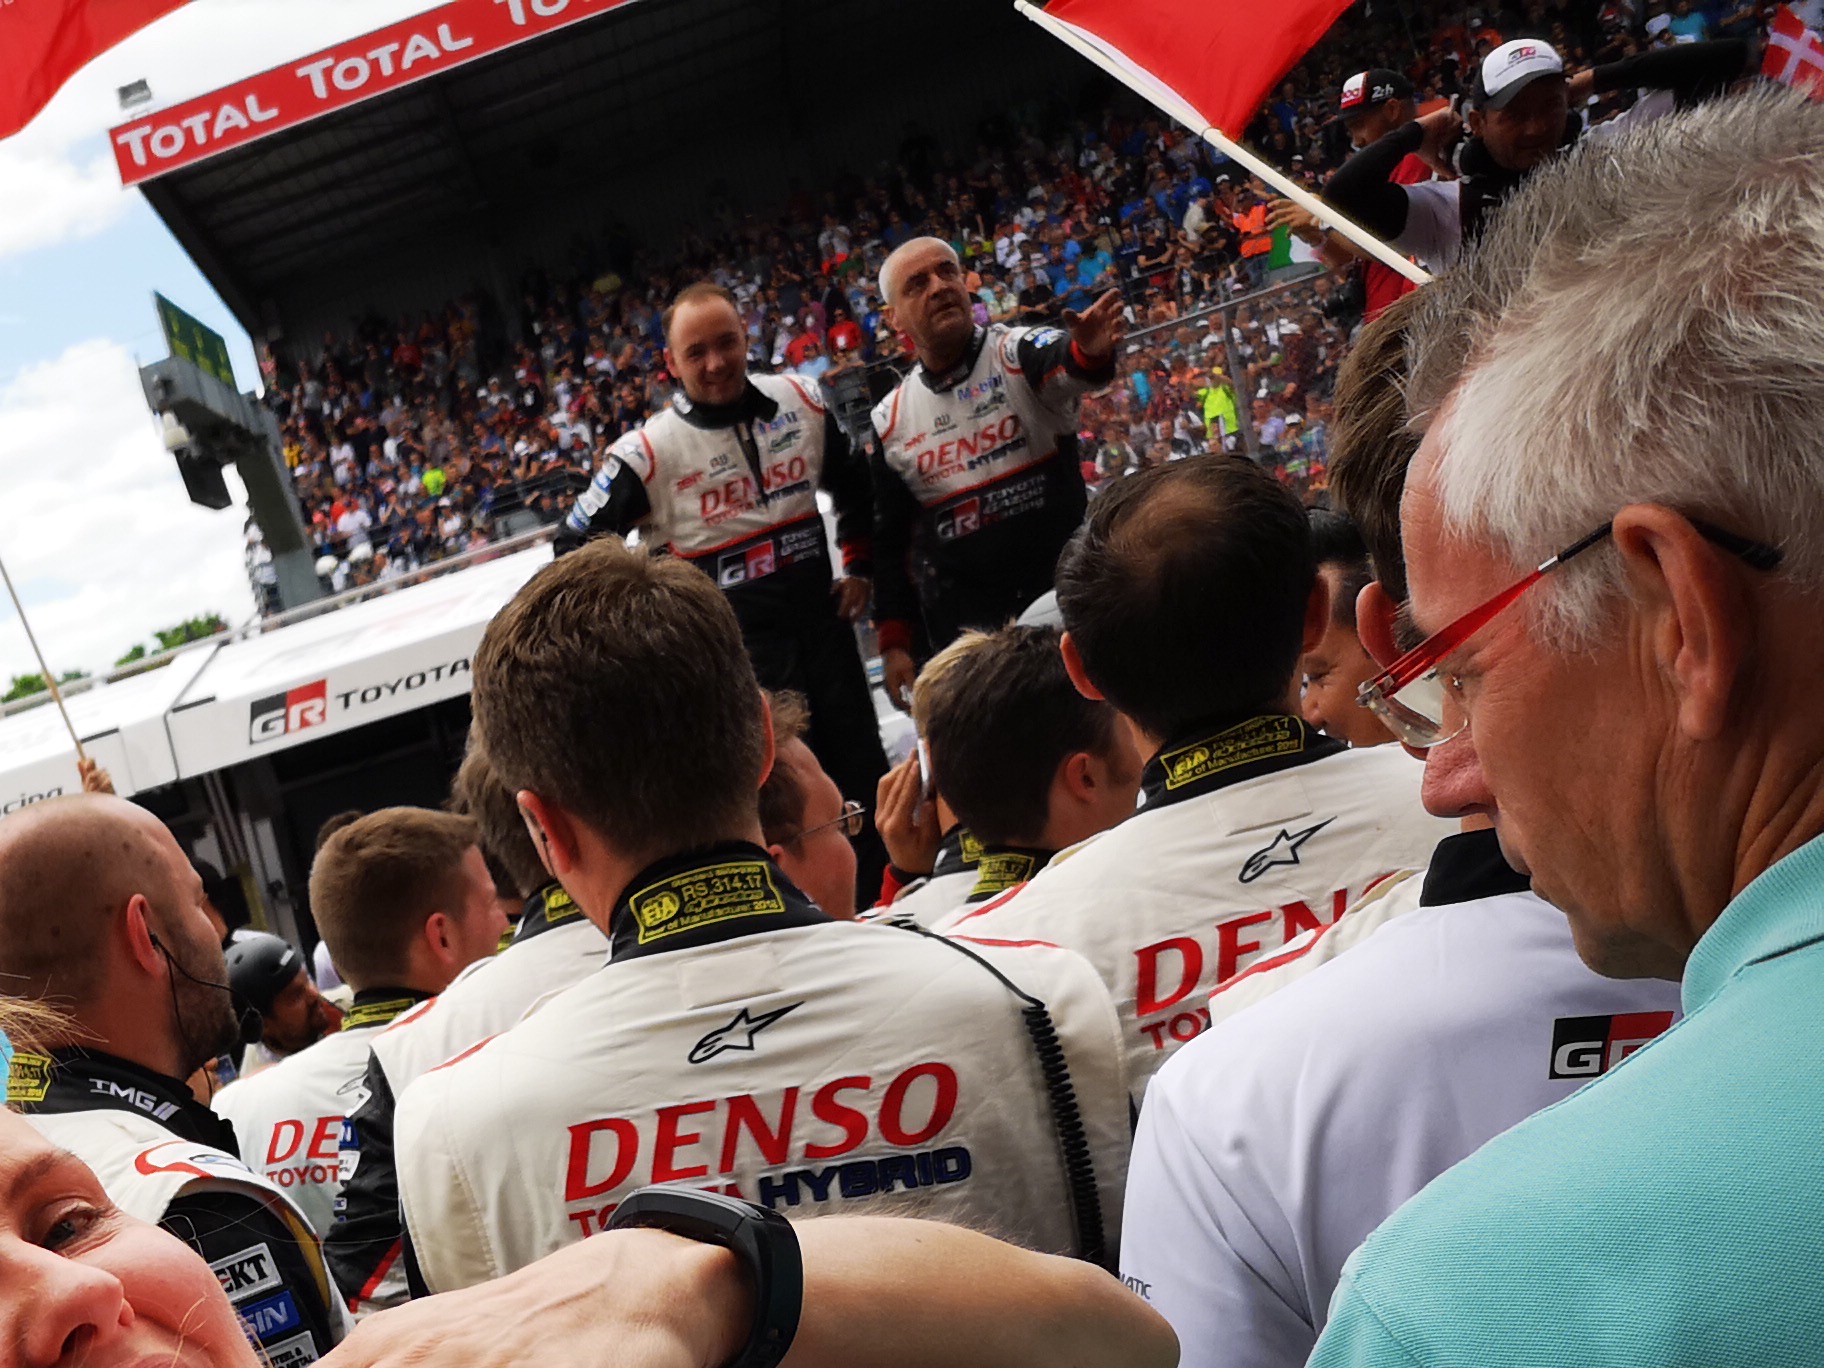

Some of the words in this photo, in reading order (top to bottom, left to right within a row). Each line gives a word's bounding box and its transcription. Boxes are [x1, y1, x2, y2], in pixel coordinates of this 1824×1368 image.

[116, 94, 280, 168] TOTAL
[296, 23, 474, 99] TOTAL
[916, 414, 1020, 476] DENSO
[250, 695, 326, 743] GR
[336, 657, 471, 711] TOYOTA
[682, 875, 763, 901] RS.314.17
[1135, 869, 1400, 1018] DEN
[564, 1062, 958, 1202] DENSO
[266, 1164, 340, 1187] TOYOT
[759, 1145, 973, 1209] HYBRID
[244, 1301, 289, 1334] SIN
